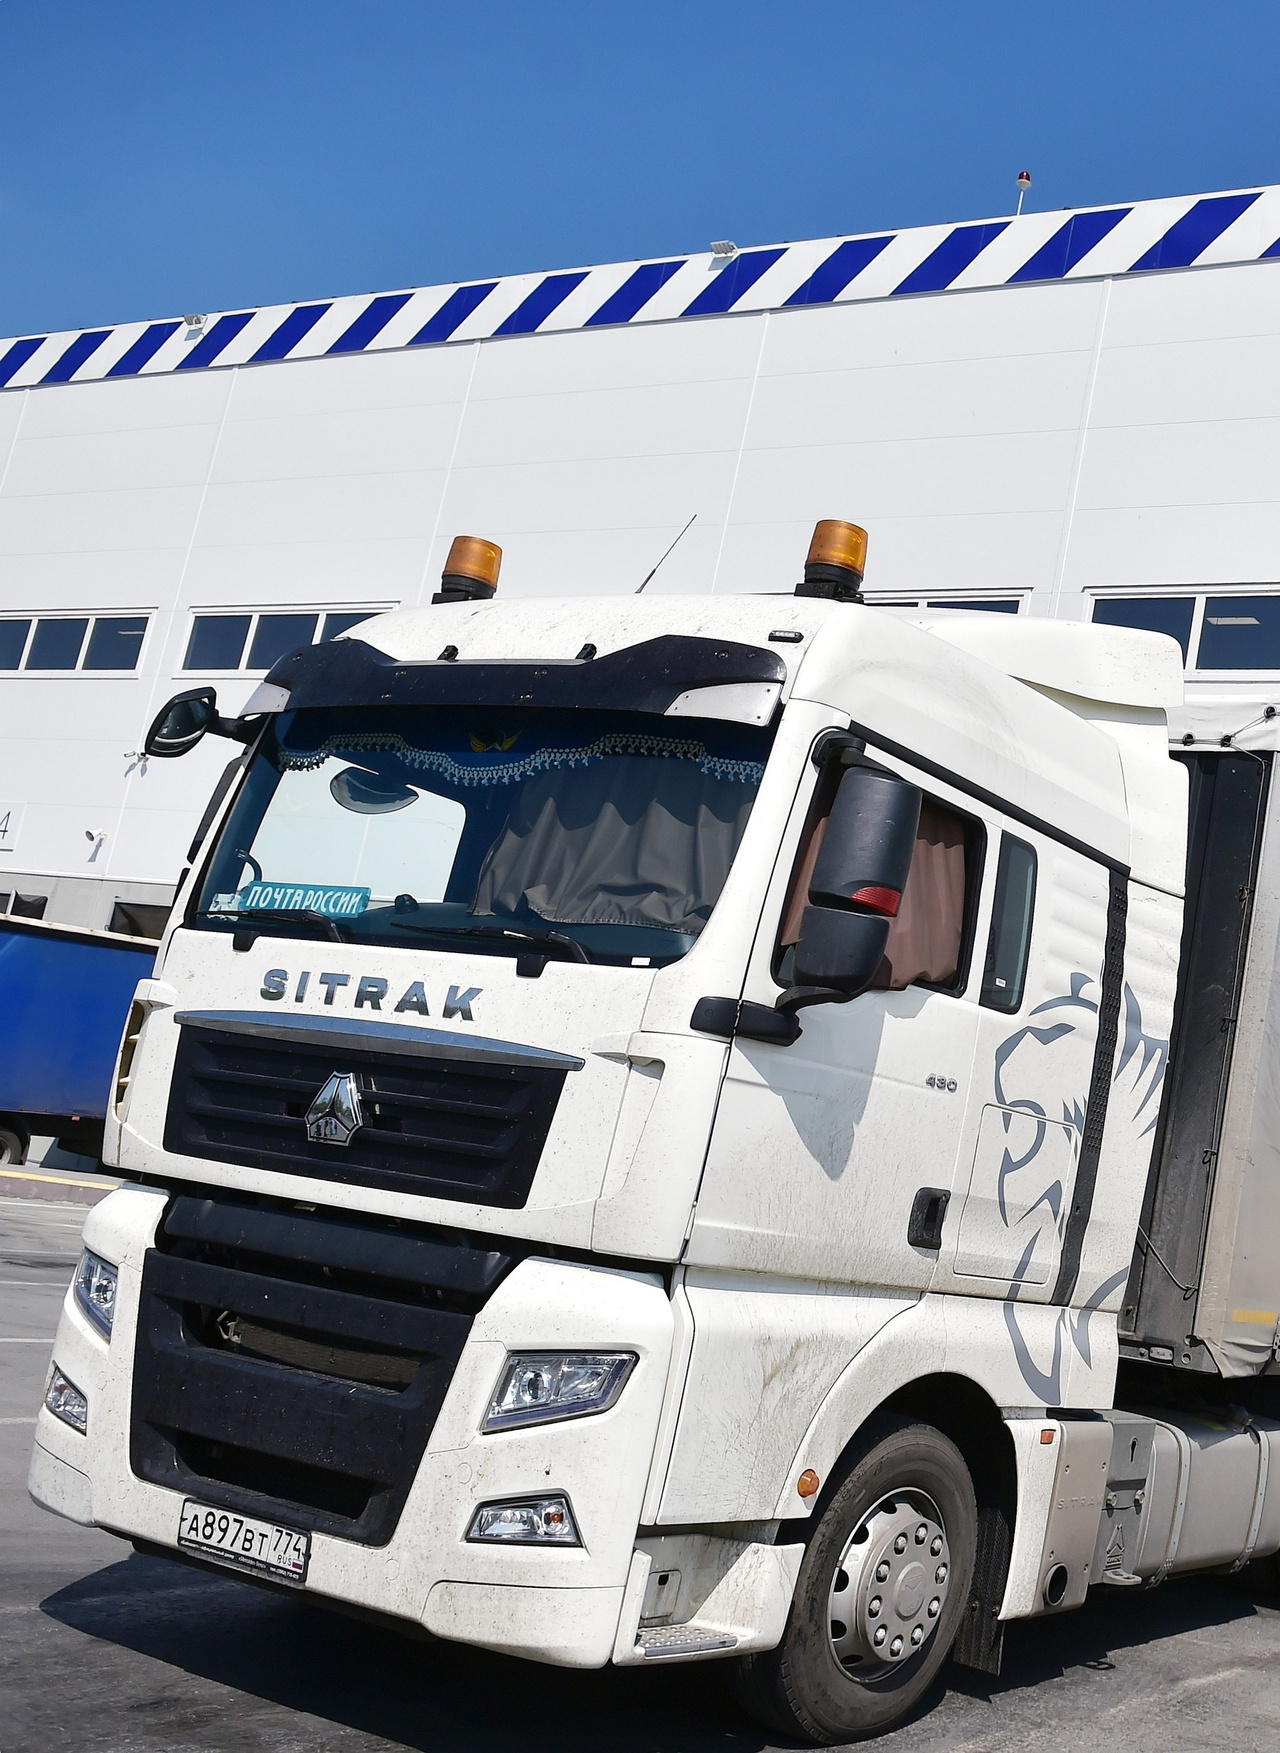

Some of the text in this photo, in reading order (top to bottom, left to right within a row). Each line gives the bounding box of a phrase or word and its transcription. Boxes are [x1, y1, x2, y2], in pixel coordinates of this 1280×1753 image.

[260, 968, 484, 1021] SITRAK
[926, 1073, 958, 1093] 430
[276, 1553, 292, 1567] RUS
